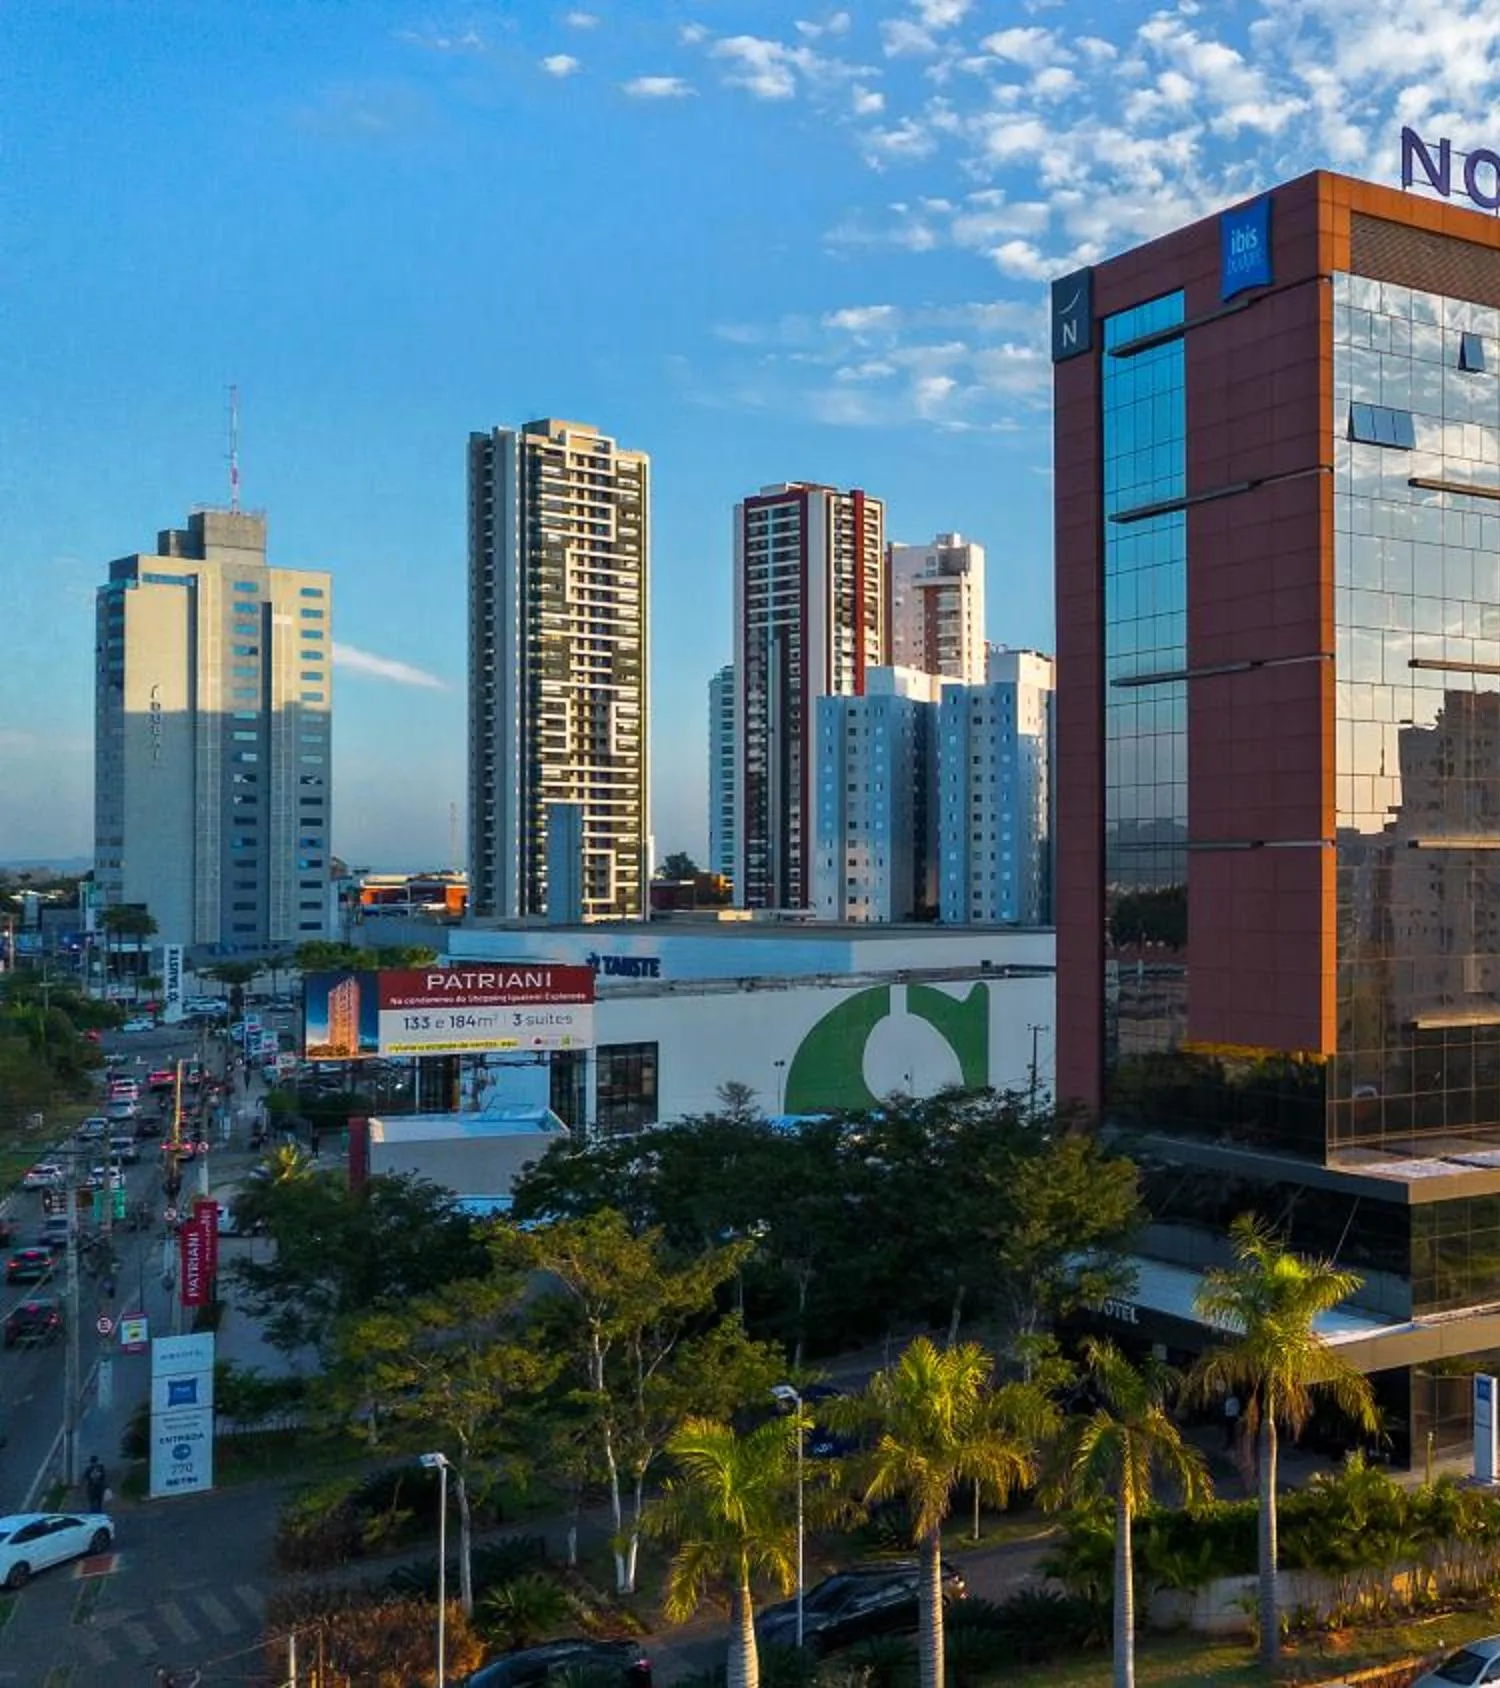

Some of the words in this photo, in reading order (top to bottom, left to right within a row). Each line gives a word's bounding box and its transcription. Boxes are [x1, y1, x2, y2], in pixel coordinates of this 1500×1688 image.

[1231, 224, 1257, 256] ibis
[1063, 319, 1077, 348] N
[427, 972, 551, 990] PATRIANI
[404, 1016, 430, 1030] 133
[435, 1019, 445, 1029] e
[512, 1013, 522, 1027] 3
[187, 1232, 199, 1296] PATRIANI
